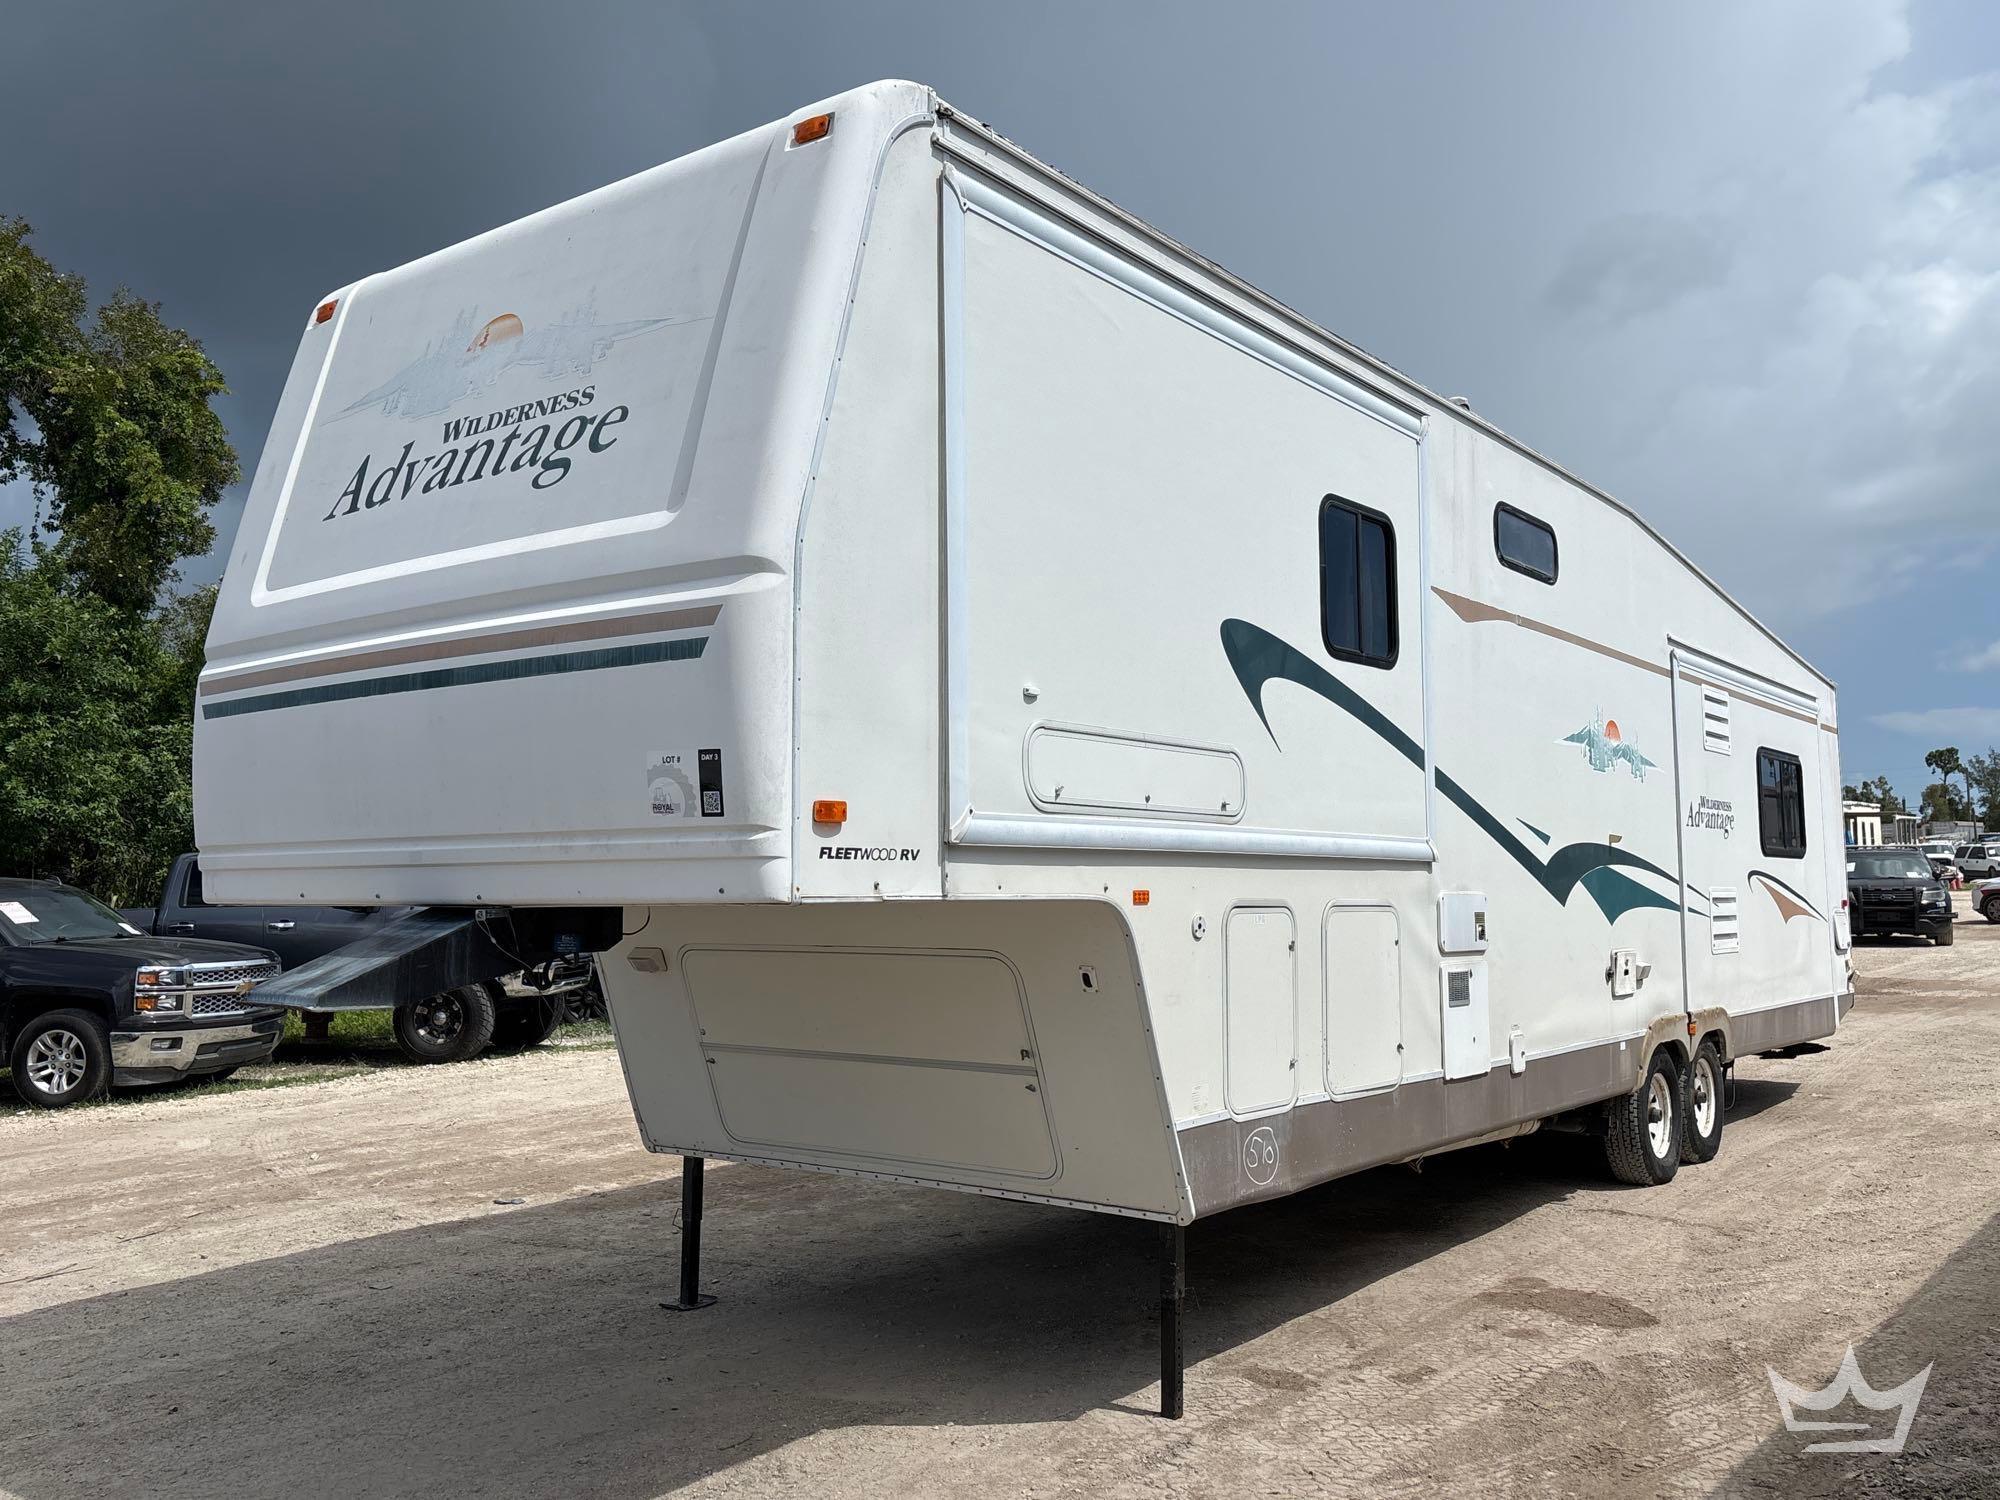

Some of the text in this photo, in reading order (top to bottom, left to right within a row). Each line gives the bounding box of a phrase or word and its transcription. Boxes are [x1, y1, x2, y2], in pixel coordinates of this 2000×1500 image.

[442, 385, 596, 444] WILDERNESS
[322, 405, 629, 522] Advantage
[662, 756, 675, 764] LOT
[1686, 801, 1734, 839] Advantage
[819, 847, 920, 860] FLEETWOOD RV
